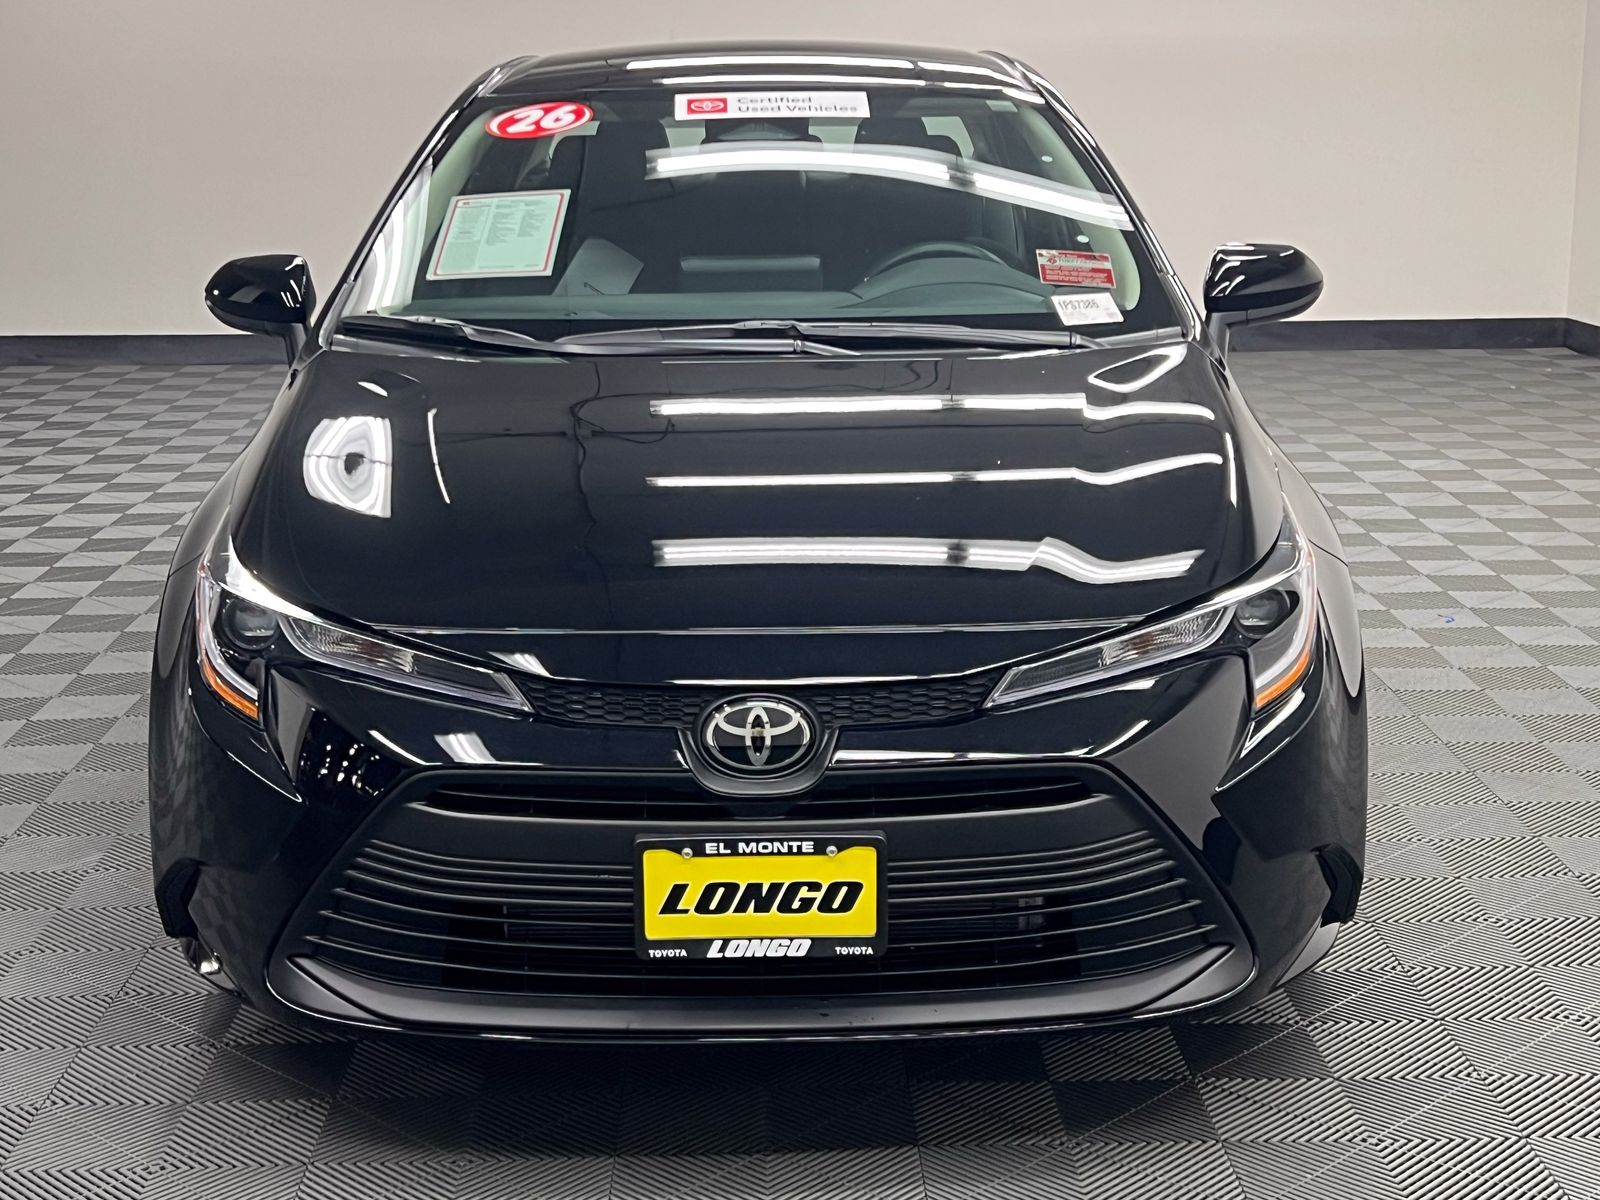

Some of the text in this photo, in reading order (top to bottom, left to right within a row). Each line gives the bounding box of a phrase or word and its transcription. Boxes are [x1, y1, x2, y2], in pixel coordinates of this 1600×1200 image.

[737, 96, 812, 104] Certified
[737, 104, 859, 113] Used Vehicles
[505, 104, 578, 134] 26
[705, 841, 815, 855] EL MONTE
[658, 881, 864, 915] LONGO
[648, 949, 688, 958] TOYOTA
[706, 938, 812, 958] LONGO
[835, 946, 874, 956] TOYOTA
